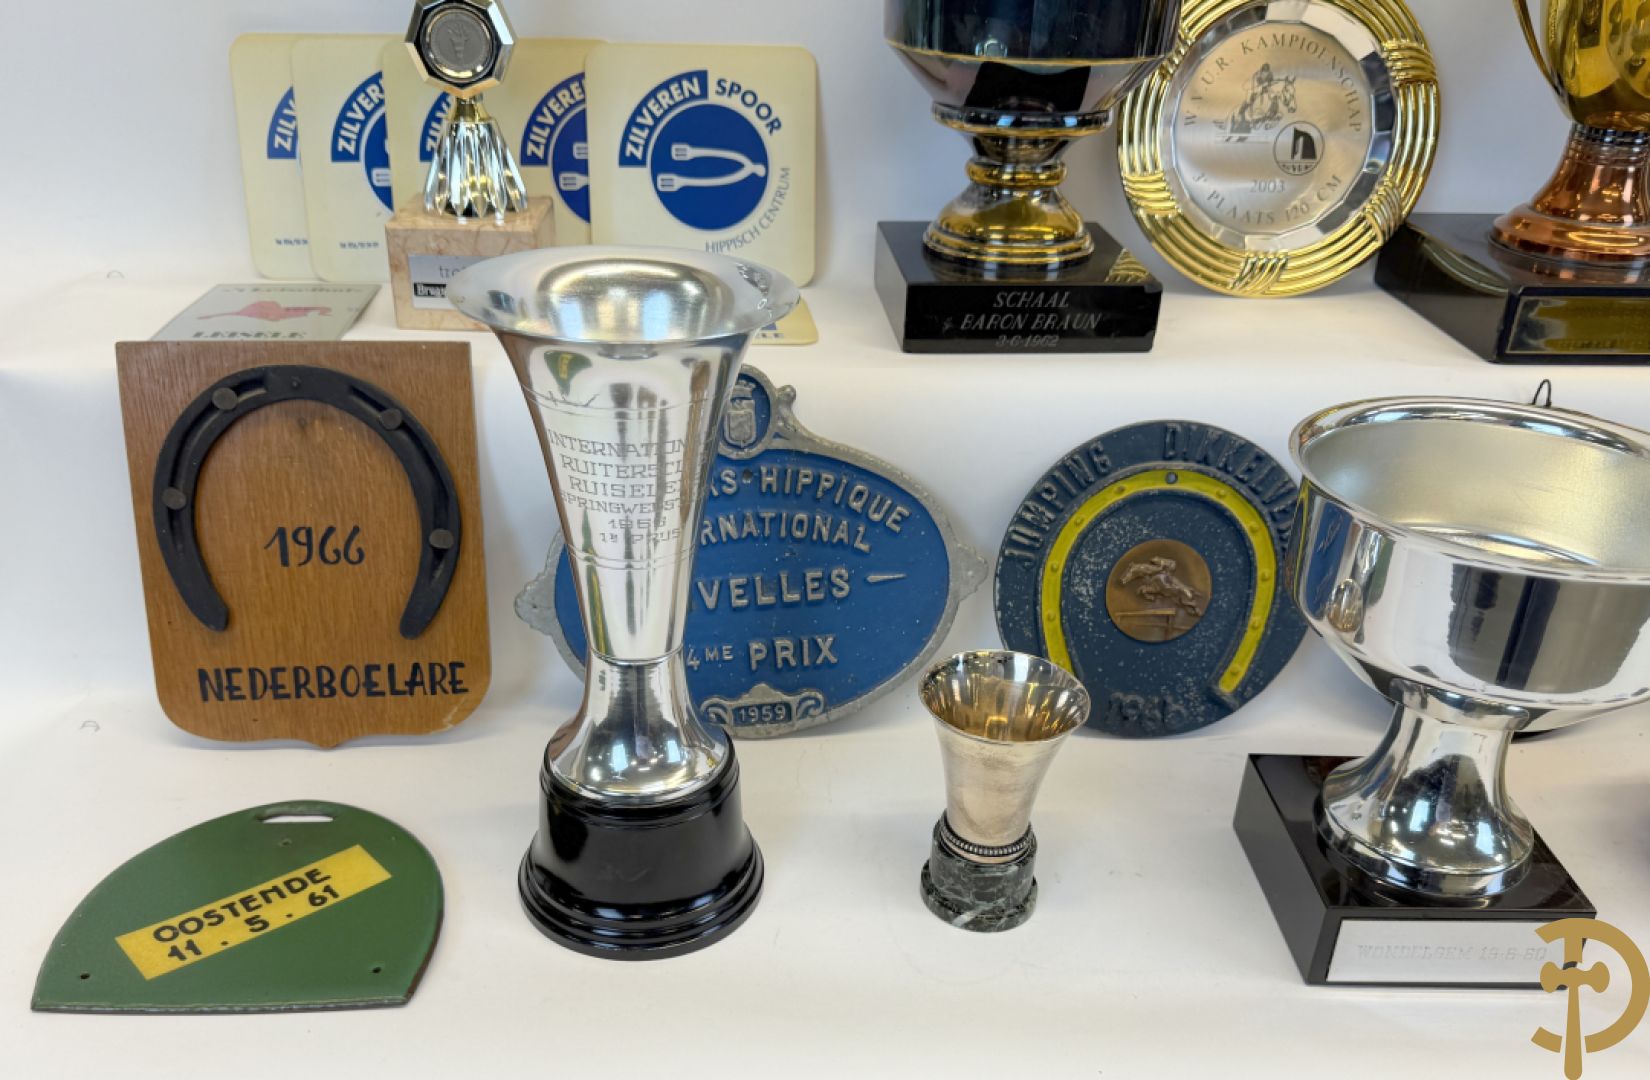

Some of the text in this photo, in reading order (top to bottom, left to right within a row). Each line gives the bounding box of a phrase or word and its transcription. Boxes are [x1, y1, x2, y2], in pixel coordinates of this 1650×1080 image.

[623, 76, 782, 161] ZILVEREN SPOOR
[1316, 174, 1342, 202] CM
[705, 166, 790, 254] HIPPISCH CENTRUM
[992, 290, 1071, 309] SCHAAL
[959, 312, 1103, 331] BARON BRAUN
[760, 465, 912, 534] HIPPIQUE
[264, 525, 366, 568] 1966
[697, 567, 851, 610] VELLES
[748, 635, 839, 671] PRIX
[197, 660, 469, 703] NEDERBOELARE
[737, 700, 786, 723] 1959
[153, 868, 332, 943] OOSTENDE
